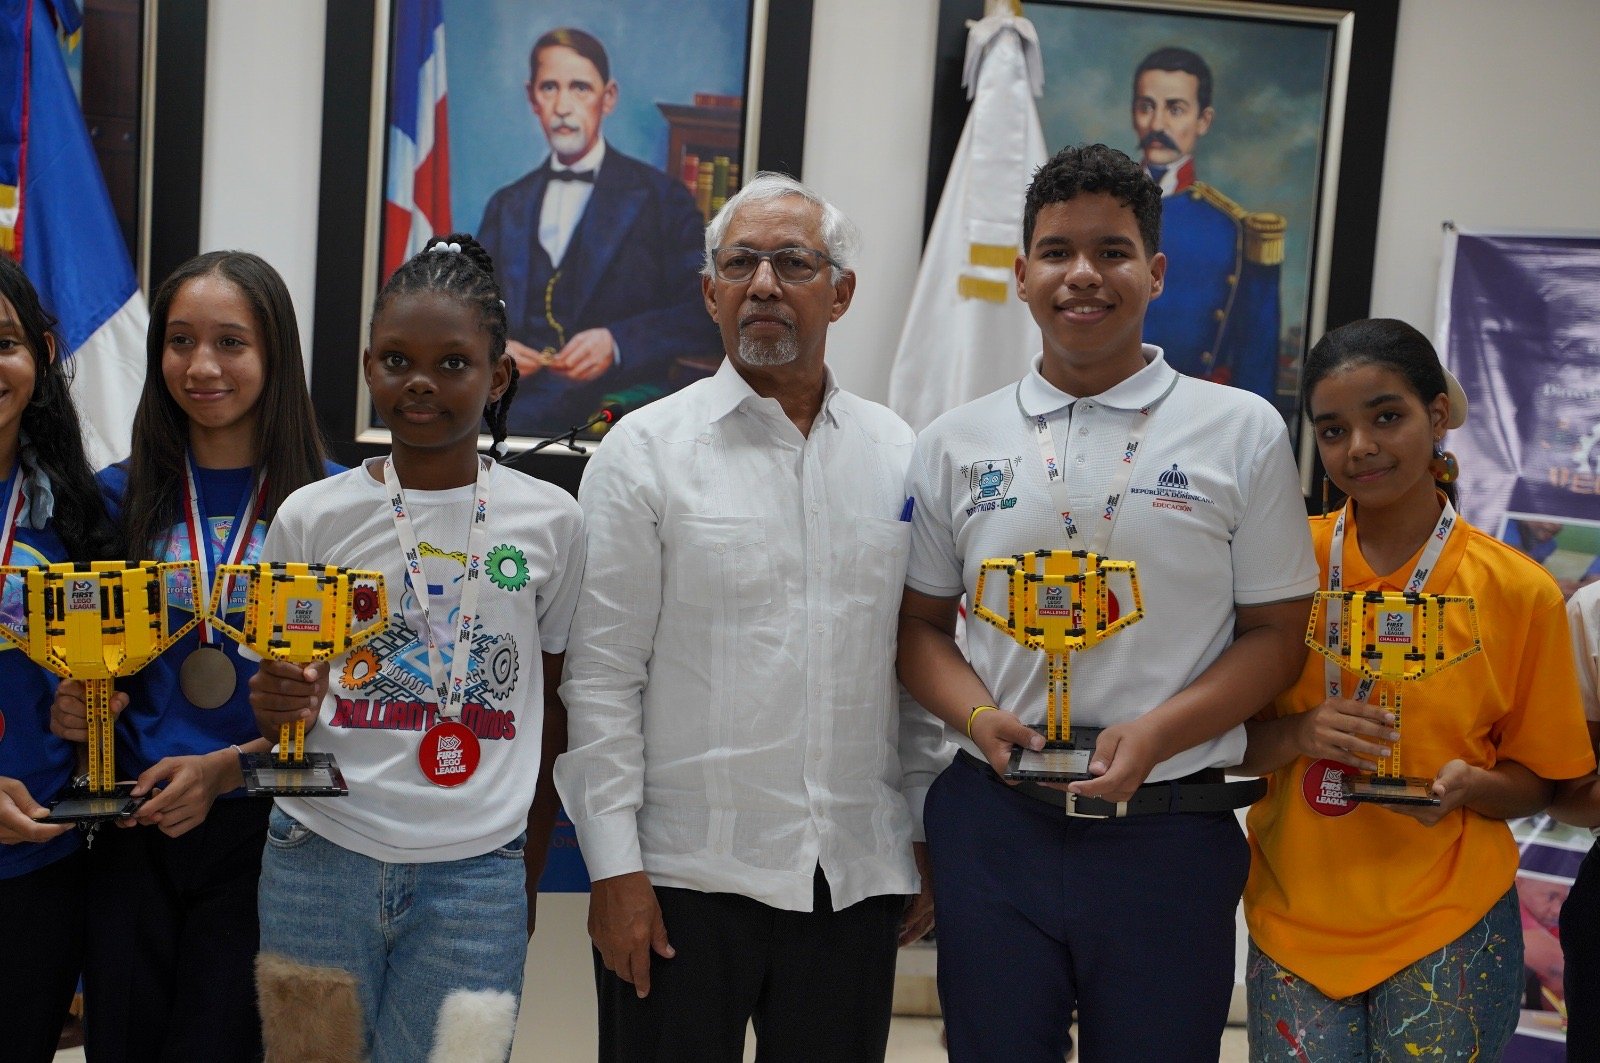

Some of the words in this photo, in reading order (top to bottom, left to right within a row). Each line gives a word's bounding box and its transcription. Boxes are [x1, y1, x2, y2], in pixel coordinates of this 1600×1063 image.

[71, 591, 94, 599] FIRST
[1379, 635, 1410, 643] CHALLENGE
[436, 749, 464, 761] FIRST
[439, 758, 462, 767] LEGO
[435, 764, 467, 776] LEAGUE
[1320, 781, 1343, 792] FIRS
[1321, 789, 1344, 799] LEGO
[1315, 795, 1348, 807] LEAGUE
